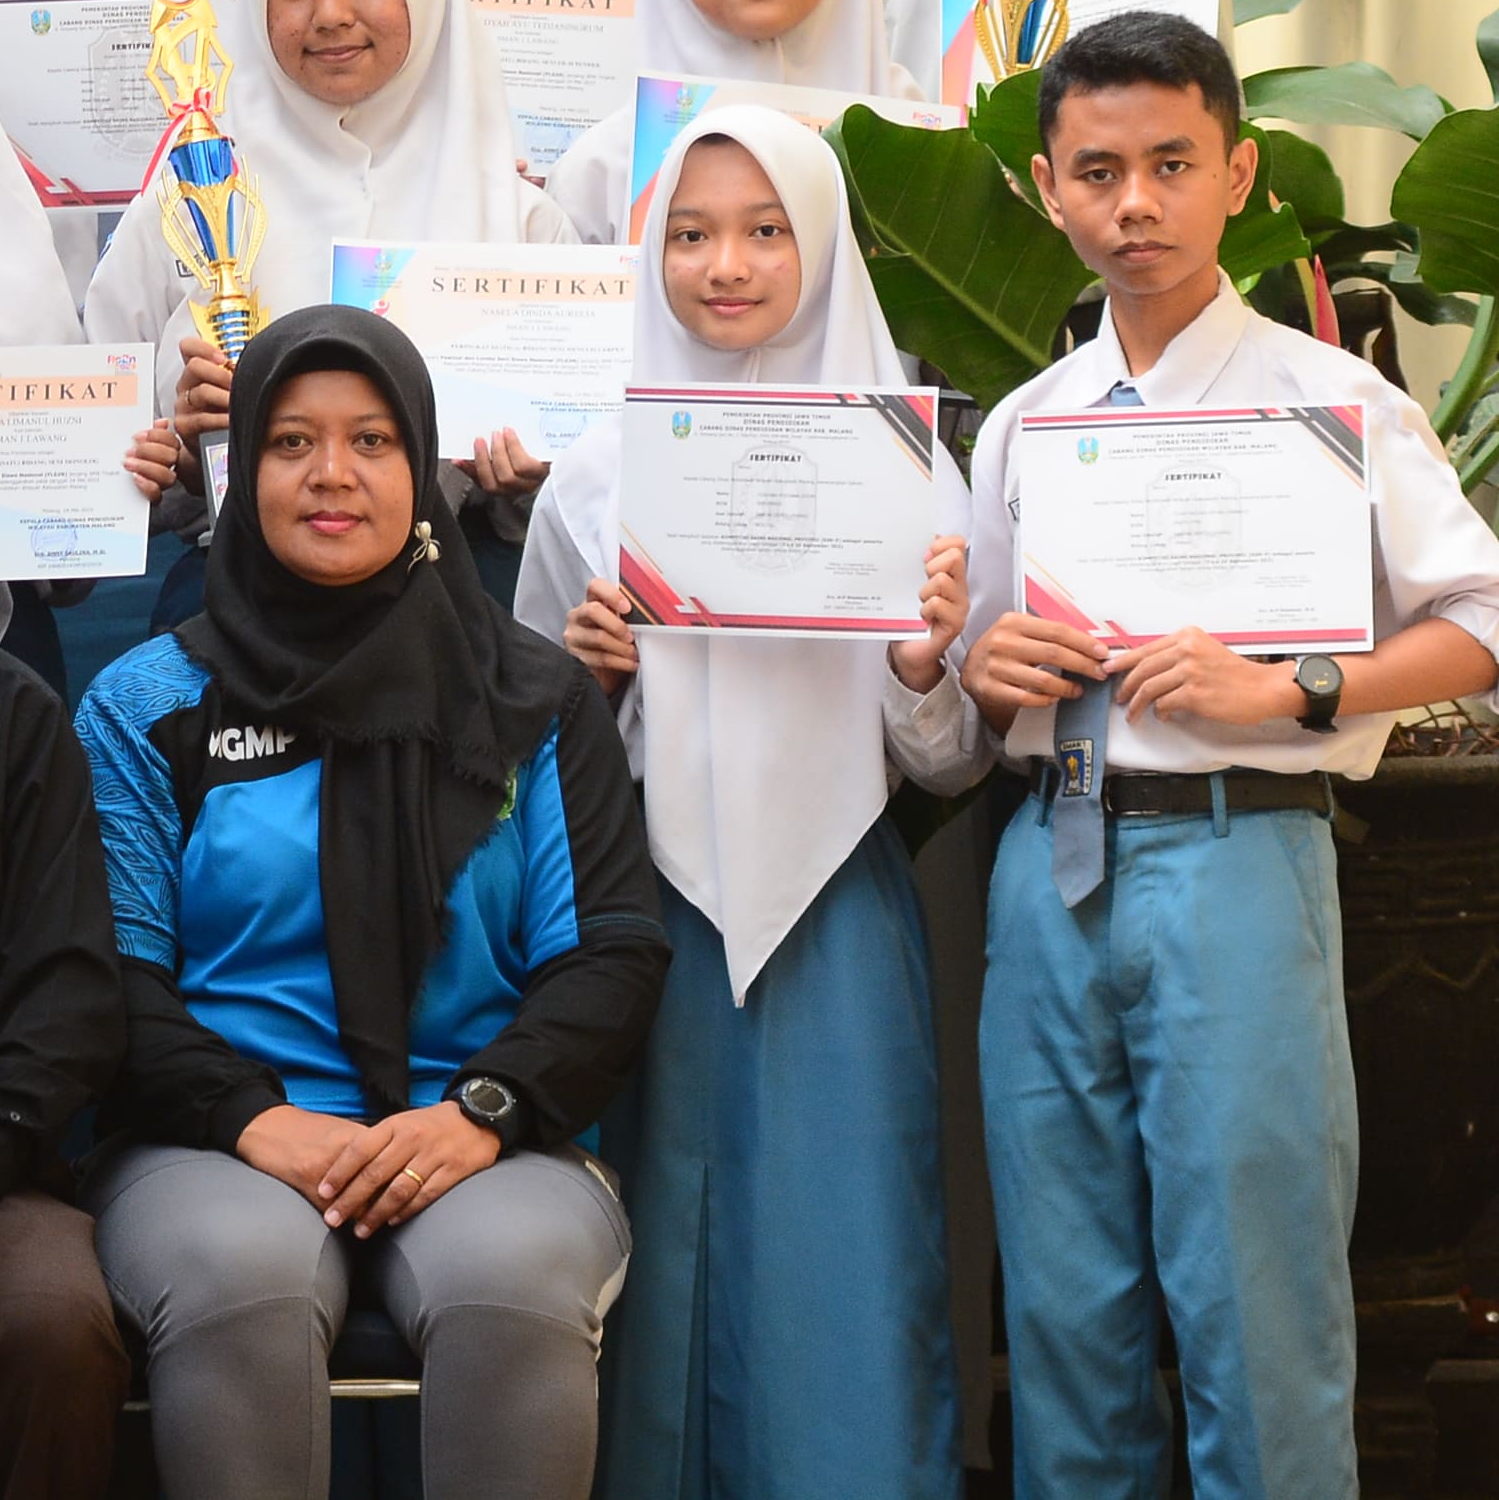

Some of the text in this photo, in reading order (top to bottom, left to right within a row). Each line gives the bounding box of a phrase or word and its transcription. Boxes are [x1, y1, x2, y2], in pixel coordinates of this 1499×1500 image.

[111, 43, 155, 51] SERTIFIK
[432, 276, 631, 296] SERTIFIKAT
[750, 454, 802, 462] SERTIFIKAT
[1164, 471, 1222, 482] SERTIFIKAT
